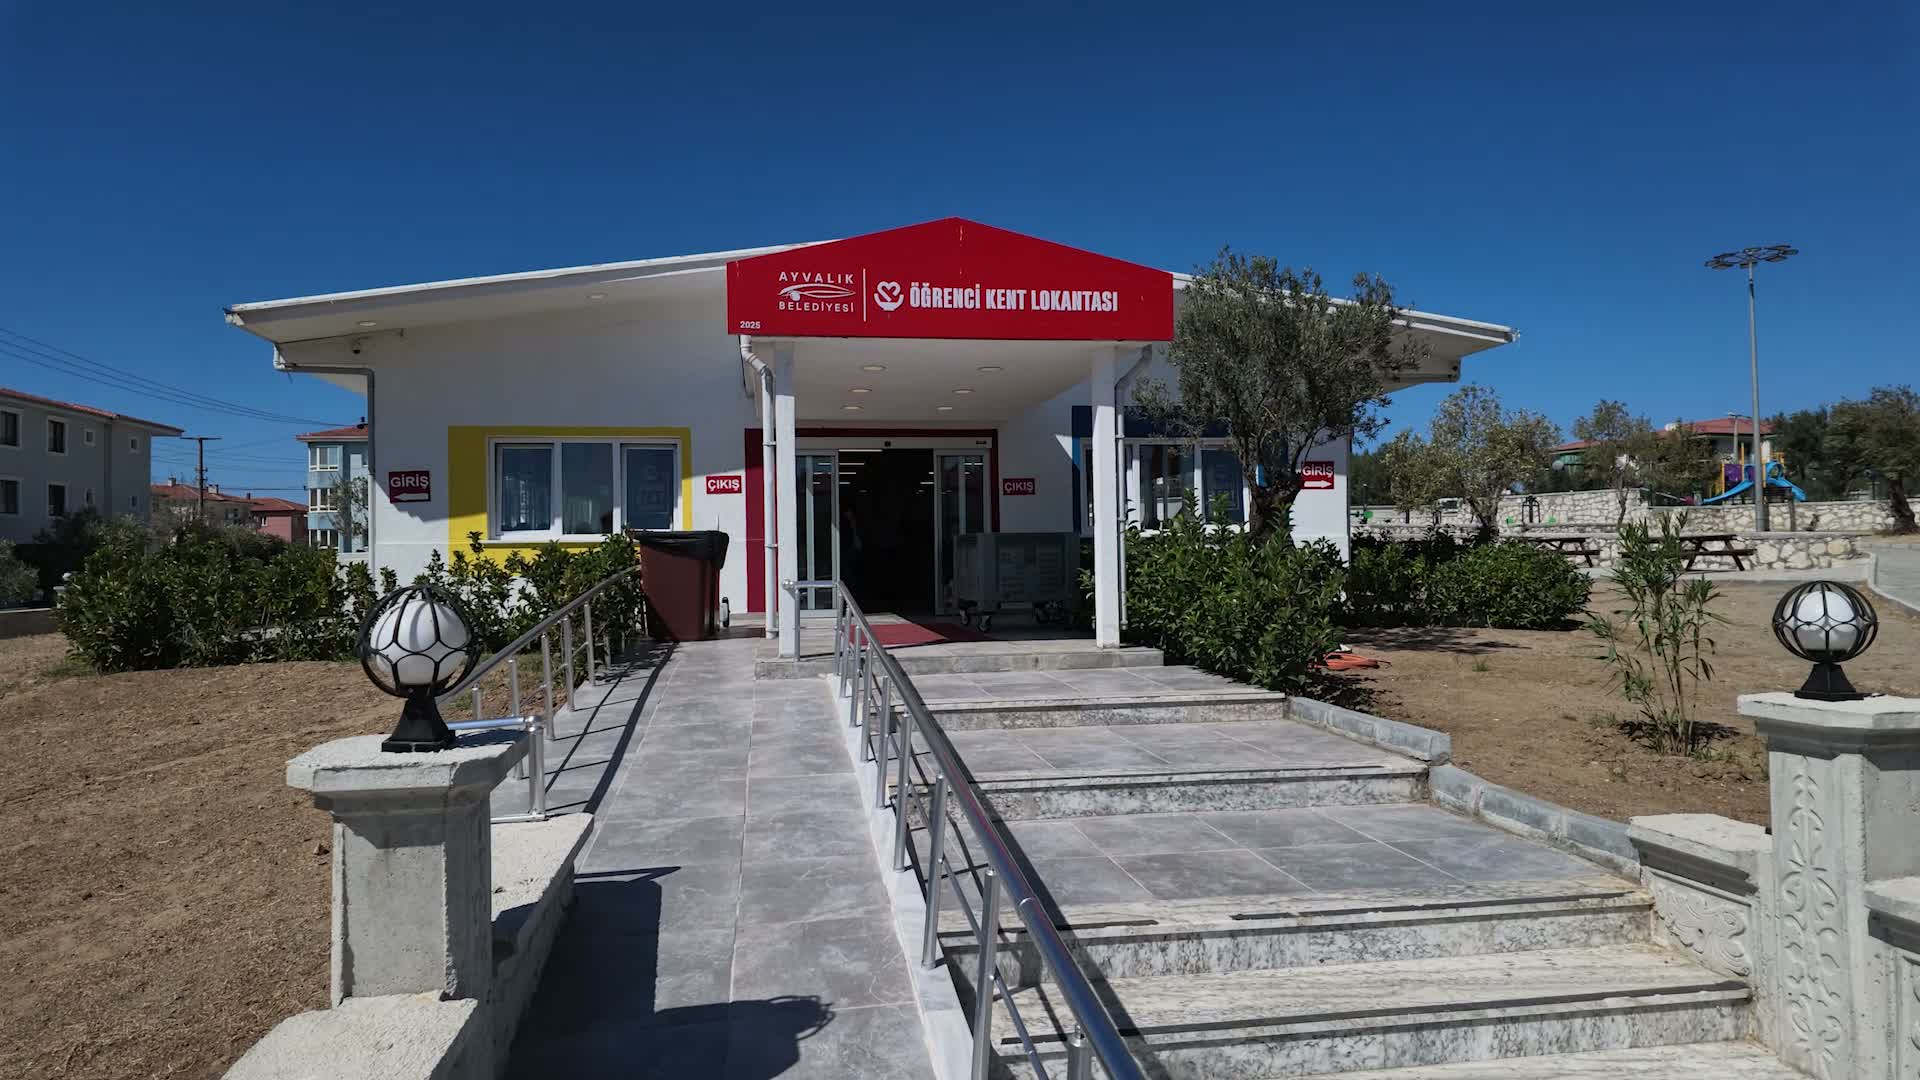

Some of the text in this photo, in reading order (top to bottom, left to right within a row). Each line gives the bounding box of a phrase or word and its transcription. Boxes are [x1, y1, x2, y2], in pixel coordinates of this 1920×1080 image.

[778, 271, 854, 284] AYVALIK
[909, 282, 1119, 312] ÖĞRENCİ KENT LOKANTASI
[778, 301, 854, 312] BELEDİYESİ
[739, 320, 761, 329] 2025
[1302, 464, 1334, 478] GİRİŞ
[390, 474, 429, 489] GİRİŞ
[707, 479, 740, 491] ÇIKIŞ
[1004, 481, 1034, 493] ÇIKIŞ
